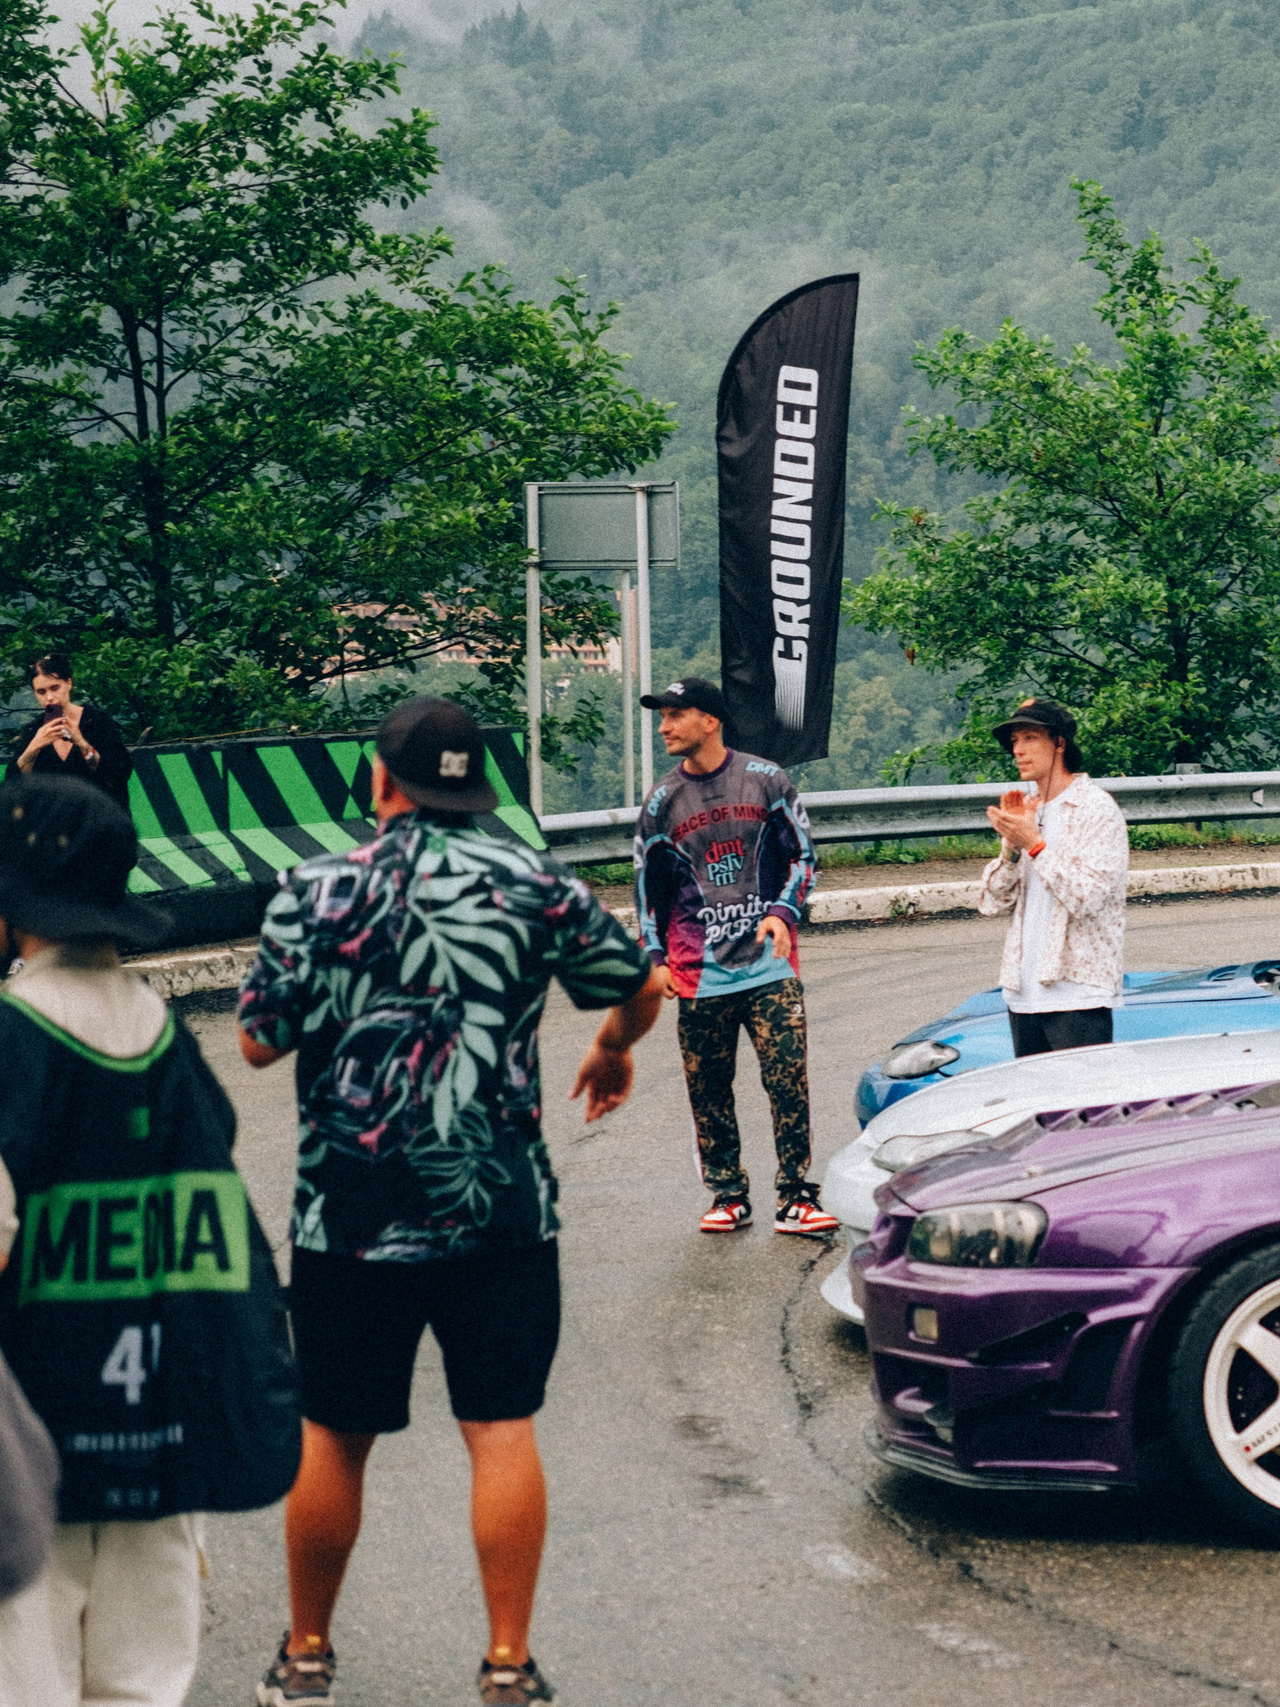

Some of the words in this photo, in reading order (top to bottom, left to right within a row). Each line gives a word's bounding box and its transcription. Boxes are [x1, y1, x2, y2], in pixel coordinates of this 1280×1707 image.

[770, 365, 819, 729] GROUNDED
[745, 761, 779, 777] DMT
[711, 806, 730, 822] OF
[705, 838, 745, 863] dmt
[29, 1188, 232, 1289] MEDIA
